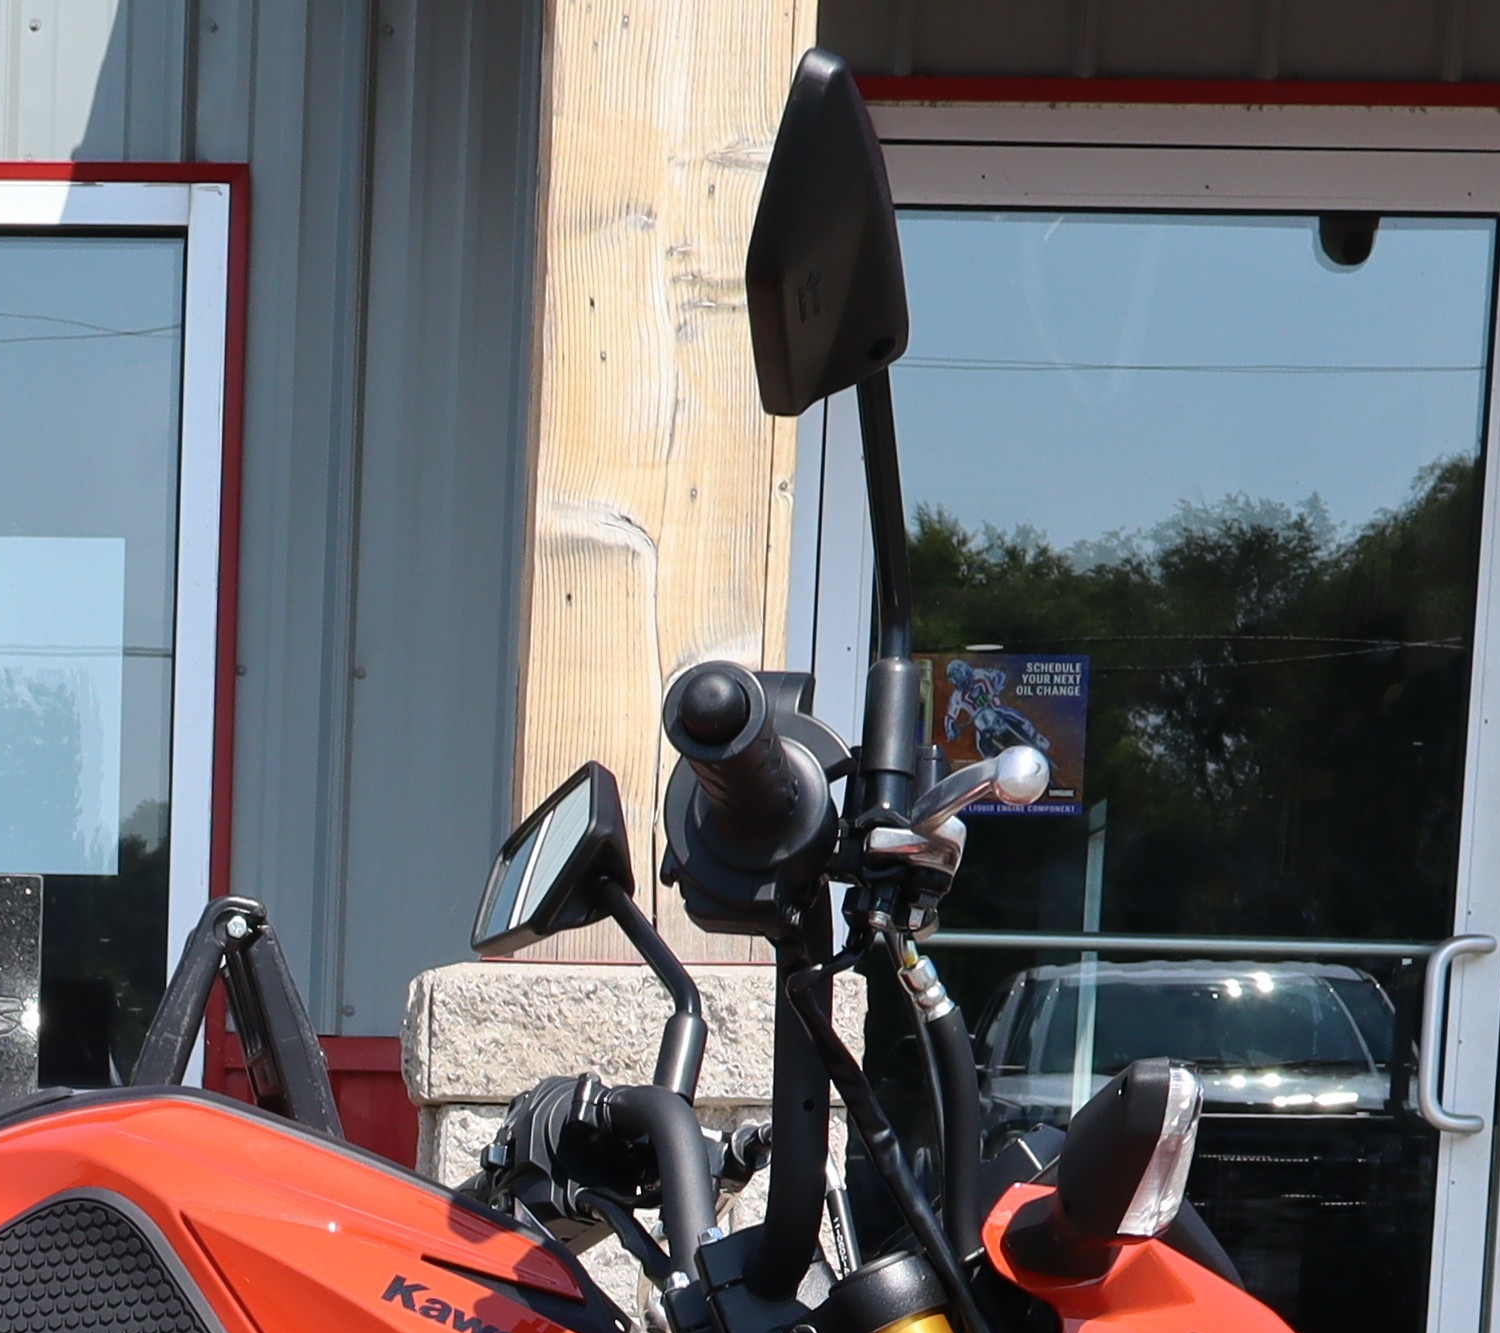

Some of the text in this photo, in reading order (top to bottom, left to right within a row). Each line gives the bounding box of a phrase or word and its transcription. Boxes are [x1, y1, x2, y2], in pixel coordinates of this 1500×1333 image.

[1027, 662, 1081, 673] SCHEDULE
[1022, 674, 1081, 684] YOUR NEXT
[1016, 686, 1080, 696] OIL CHANGE
